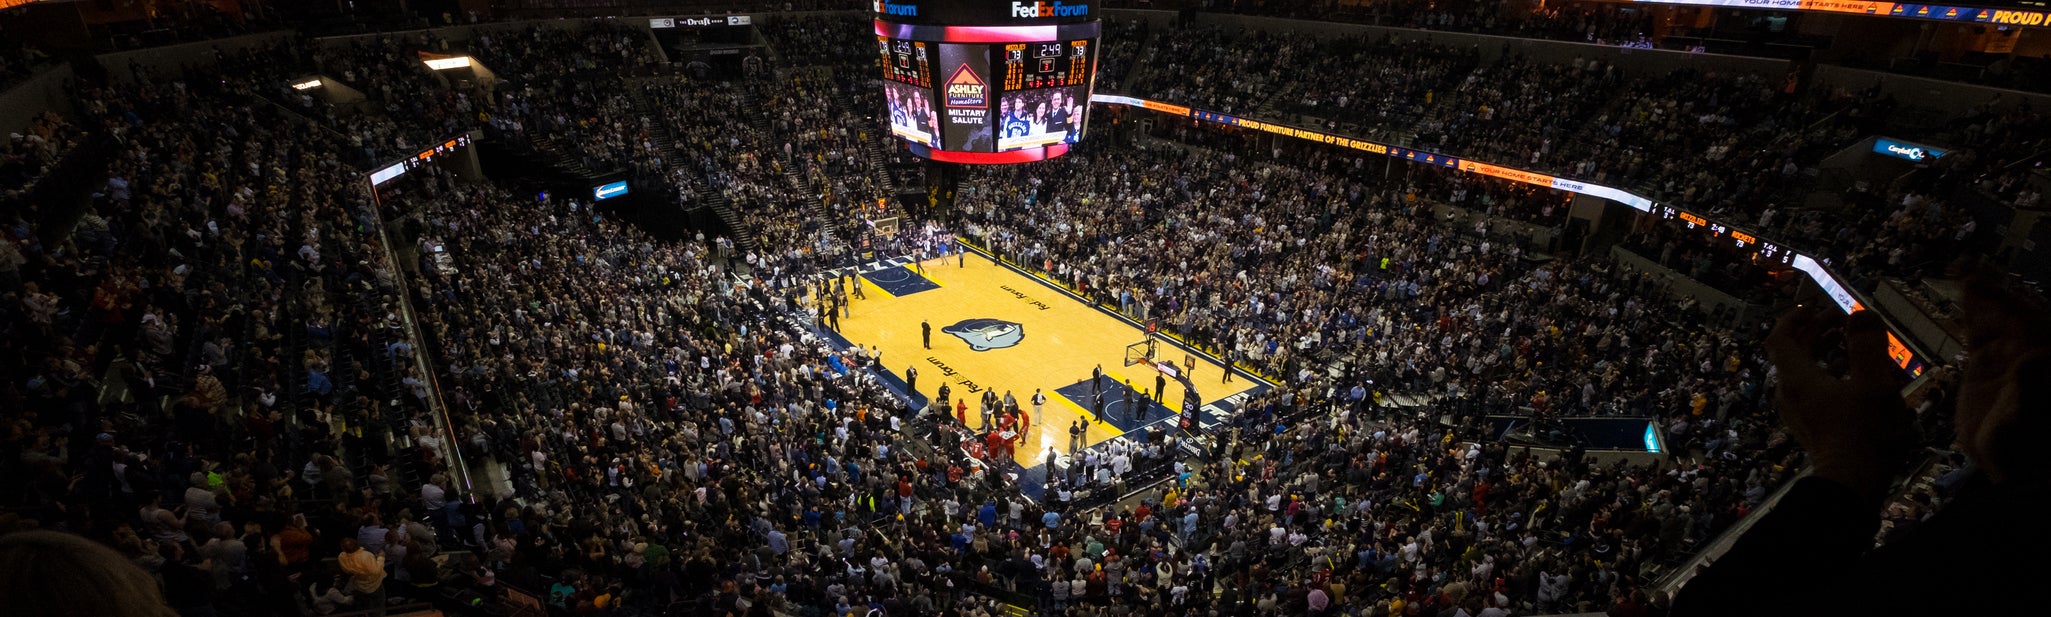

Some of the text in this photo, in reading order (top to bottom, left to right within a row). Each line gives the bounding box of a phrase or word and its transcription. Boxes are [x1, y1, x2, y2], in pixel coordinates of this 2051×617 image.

[1012, 1, 1088, 18] FedExForum
[687, 18, 711, 26] Draft
[1992, 11, 2041, 26] PROUD
[1012, 50, 1020, 60] 73
[1076, 46, 1084, 55] 73
[948, 84, 984, 94] ASHLEY
[948, 109, 987, 117] MILITARY
[952, 116, 983, 124] SALUTE
[1238, 118, 1387, 154] PROUD FURNITURE PARTNER OF THE GRIZZLIES
[1502, 171, 1526, 179] HOME
[1527, 175, 1558, 185] STARTS
[1559, 182, 1583, 190] HERE
[1687, 221, 1695, 229] 73
[1731, 230, 1756, 245] ROCKETS
[1736, 239, 1744, 248] 73
[1782, 256, 1789, 264] 5
